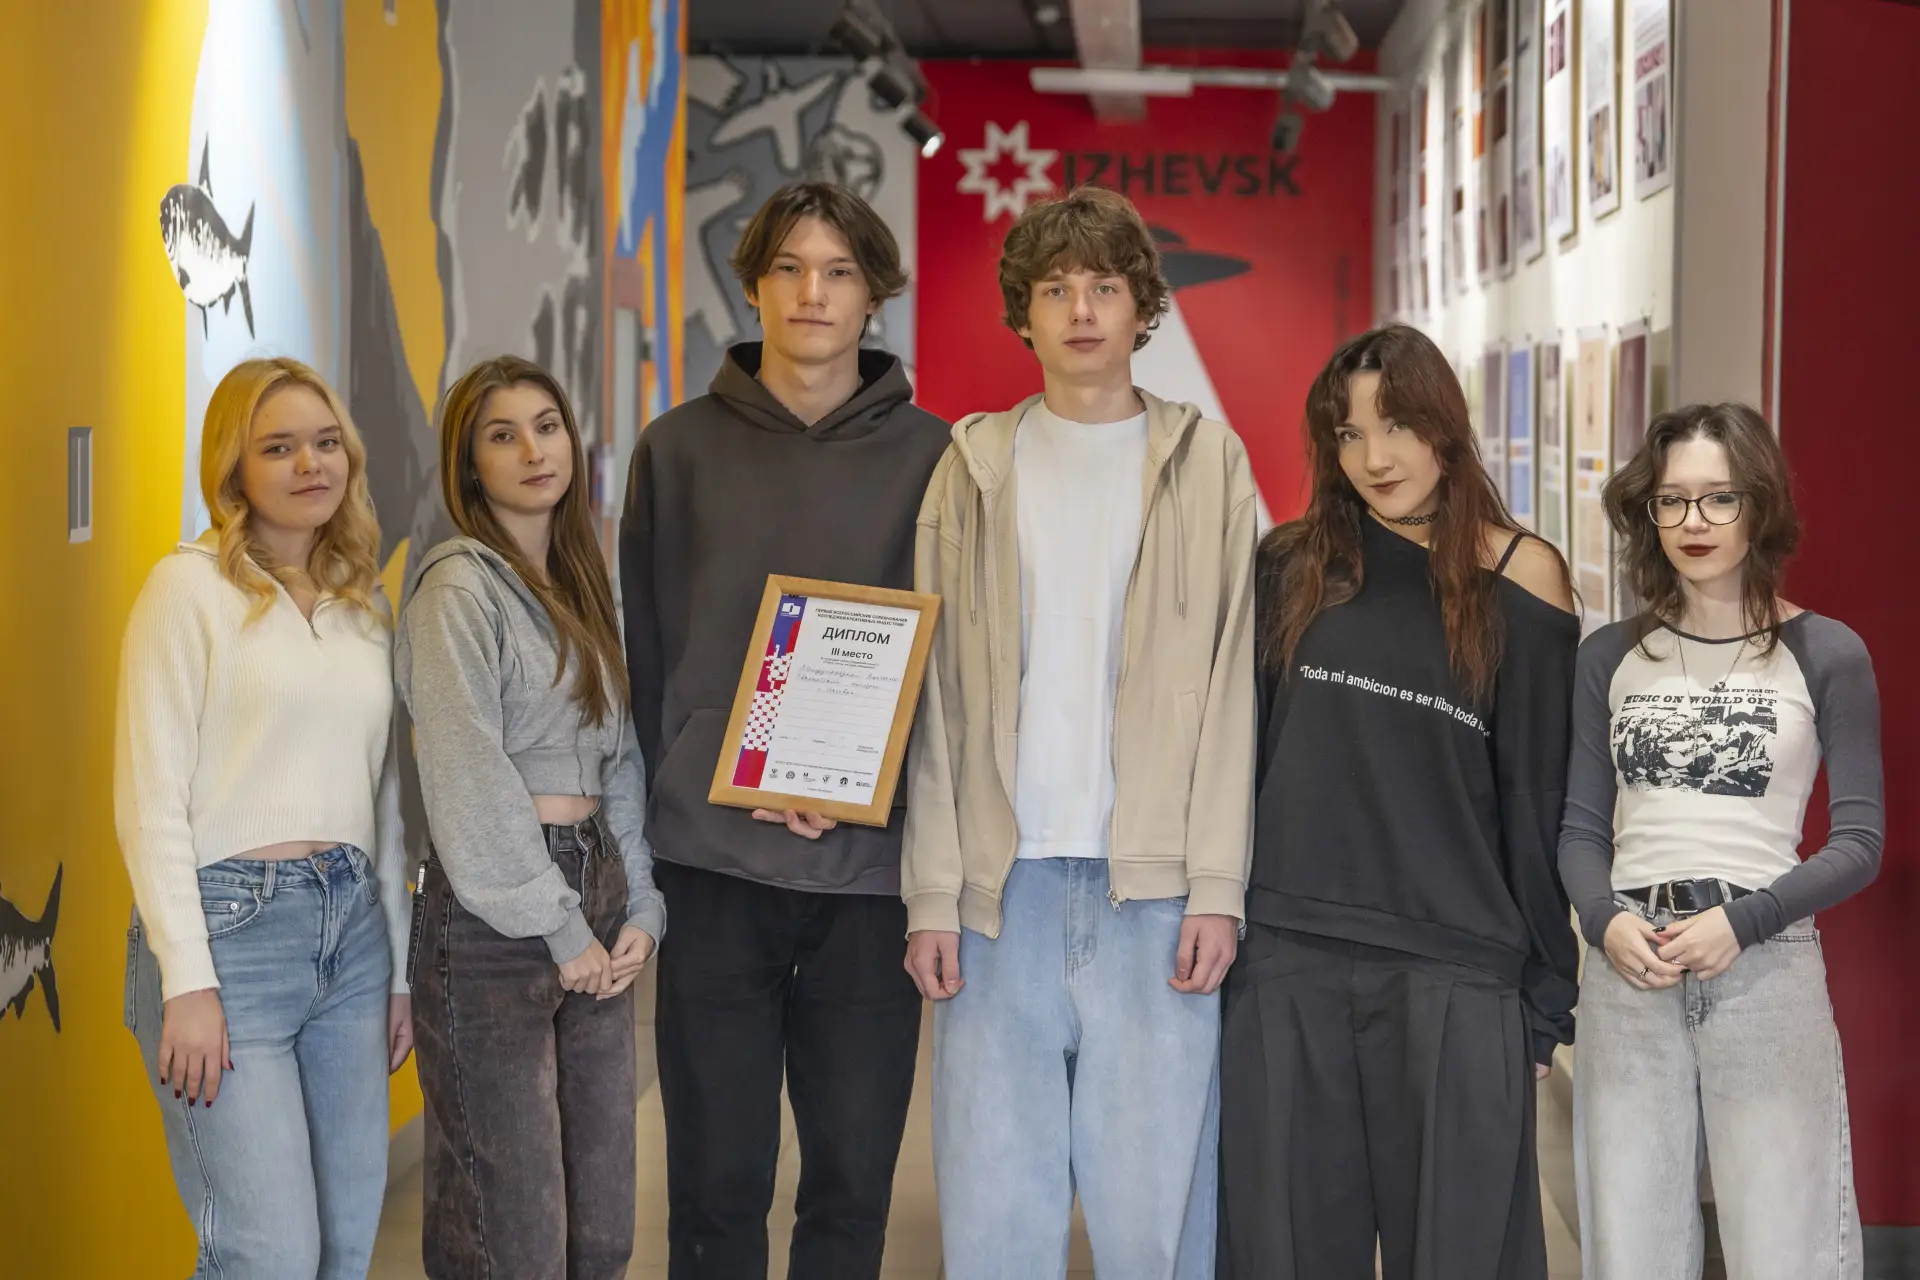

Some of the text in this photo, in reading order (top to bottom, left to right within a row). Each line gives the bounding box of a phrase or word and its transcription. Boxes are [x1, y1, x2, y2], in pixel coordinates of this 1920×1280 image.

[1063, 152, 1302, 197] IZHEVSK
[822, 626, 891, 645] ДИПЛОМ
[831, 647, 841, 656] III
[841, 650, 873, 660] место
[1330, 670, 1345, 683] mi
[1400, 689, 1413, 701] es
[1415, 693, 1433, 707] ser
[1433, 696, 1454, 715] libre
[1454, 706, 1478, 728] toda
[1623, 694, 1777, 707] MUSIC ON WORLD OFF
